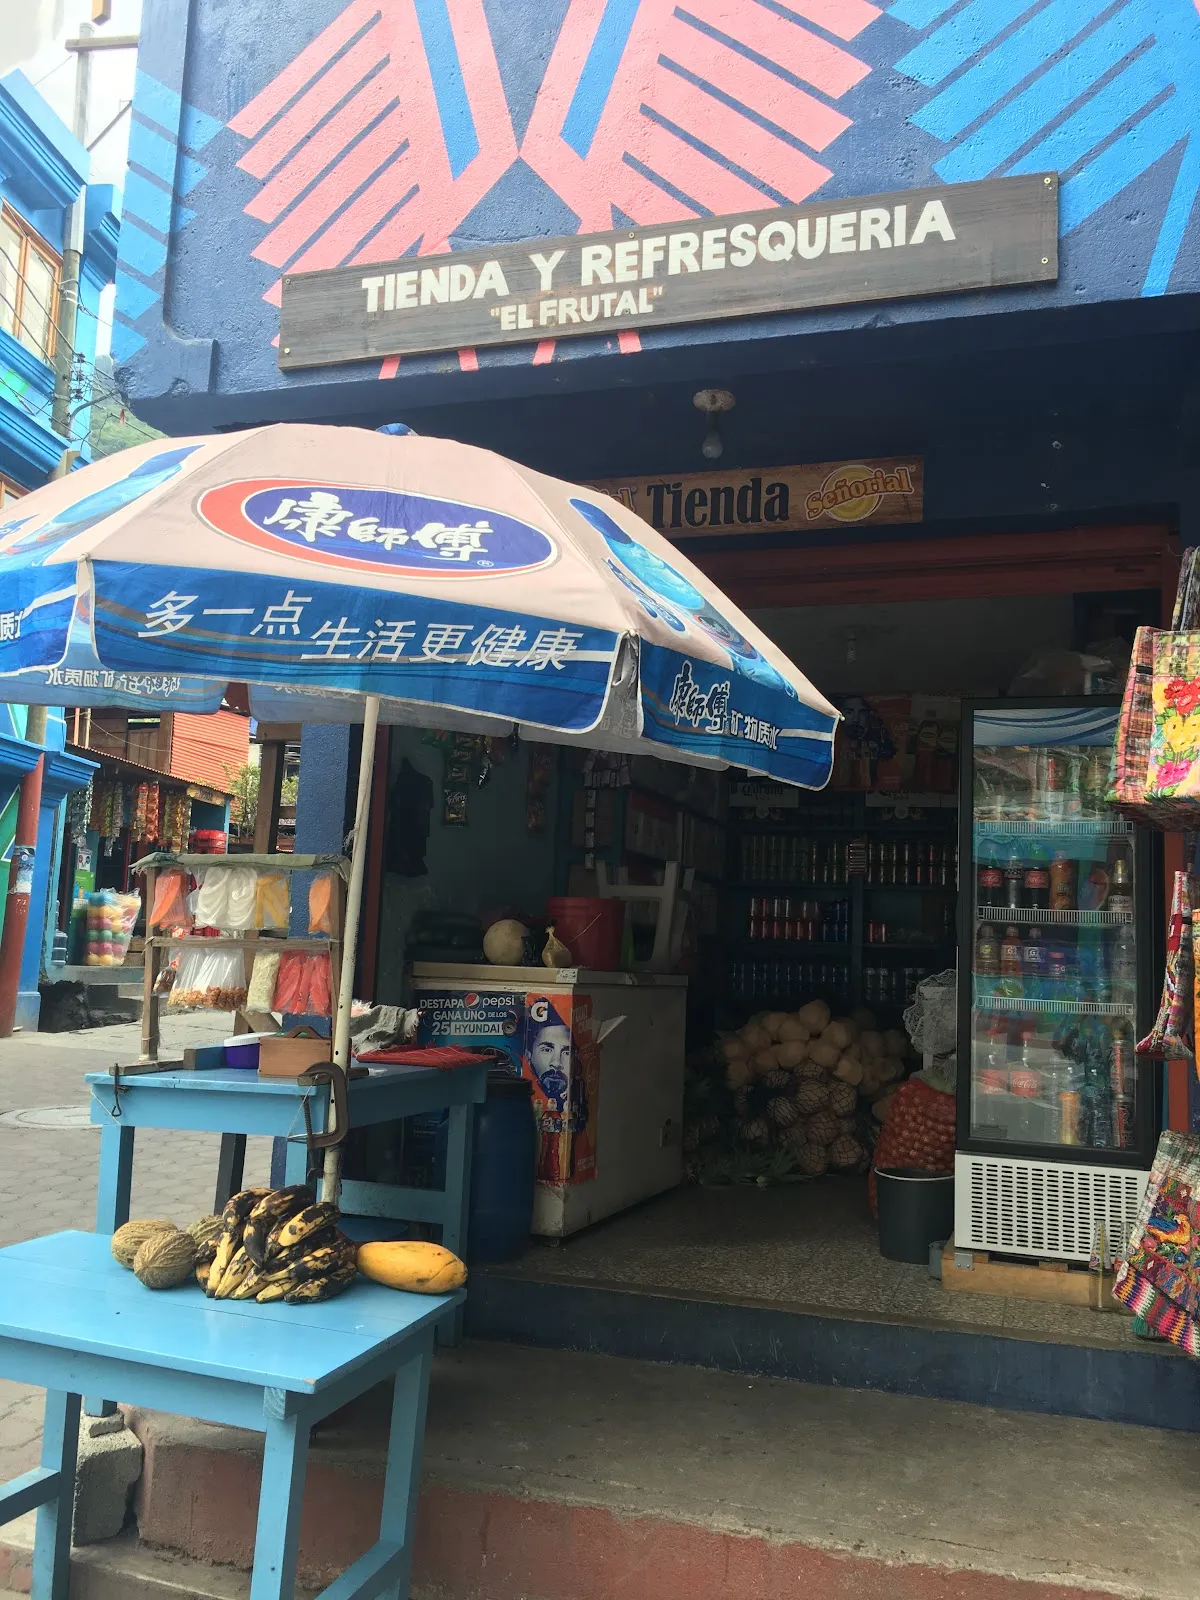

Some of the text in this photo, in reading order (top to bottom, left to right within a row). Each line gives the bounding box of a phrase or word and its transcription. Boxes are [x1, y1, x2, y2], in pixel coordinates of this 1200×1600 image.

[361, 198, 957, 314] TIENDA Y REFRESQUERIA
[647, 477, 790, 529] Tienda
[806, 466, 914, 521] Señorial
[138, 590, 584, 672] 多一点 生活更健康
[419, 994, 515, 1010] DESTAPA pepsi
[432, 1010, 462, 1021] GANA
[463, 1010, 486, 1020] UNO
[431, 1021, 500, 1036] 25 HYUNDAI
